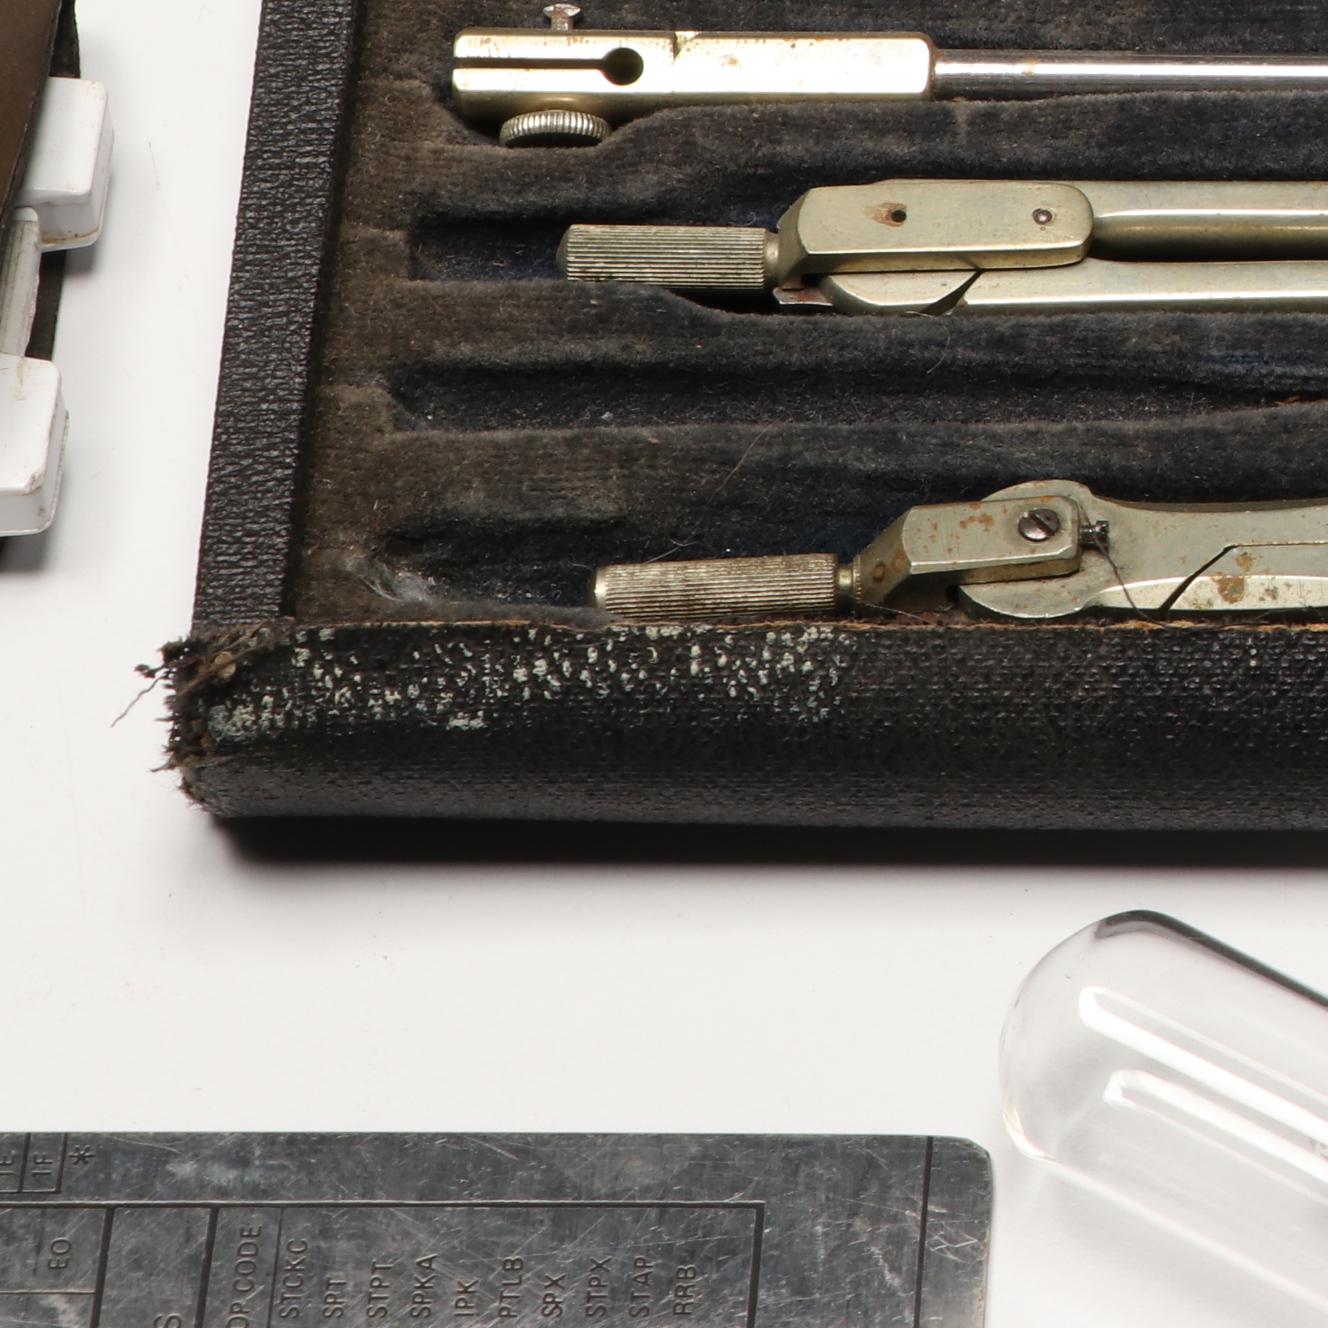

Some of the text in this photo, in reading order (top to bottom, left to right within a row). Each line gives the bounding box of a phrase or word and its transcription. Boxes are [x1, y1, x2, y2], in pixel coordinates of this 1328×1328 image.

[232, 1223, 264, 1294] CODE
[277, 1237, 309, 1320] STCKC
[366, 1257, 396, 1320] STPT
[409, 1252, 439, 1319] SPKA
[497, 1256, 525, 1319] PTLB
[584, 1255, 613, 1319] STPX
[627, 1255, 657, 1319] STAP
[672, 1263, 698, 1317] RRB
[322, 1276, 349, 1320] SPT
[454, 1278, 481, 1318] IPK
[540, 1272, 568, 1319] SPX
